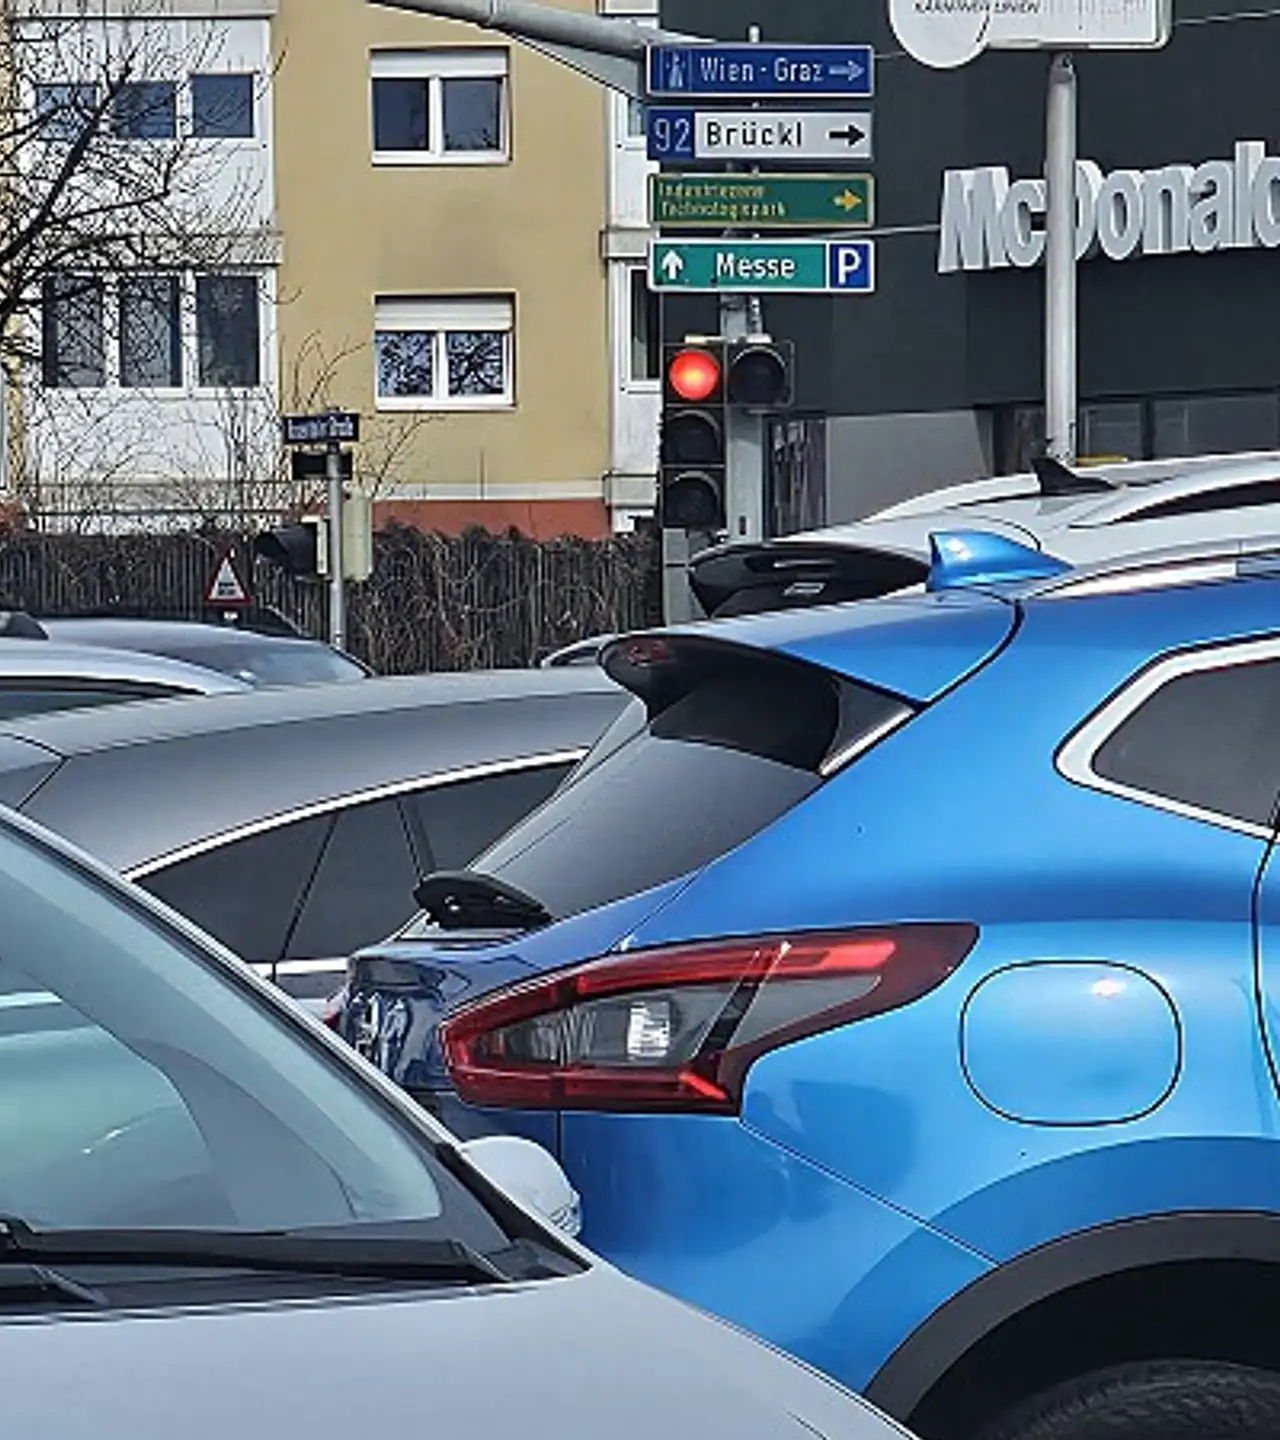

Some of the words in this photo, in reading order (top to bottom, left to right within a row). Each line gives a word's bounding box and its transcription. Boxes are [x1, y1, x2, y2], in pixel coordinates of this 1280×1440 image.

[700, 57, 754, 82] Wien
[773, 57, 824, 82] Graz
[655, 118, 691, 152] 92
[707, 121, 802, 147] Brückl
[716, 252, 795, 278] Messe
[838, 248, 861, 284] P
